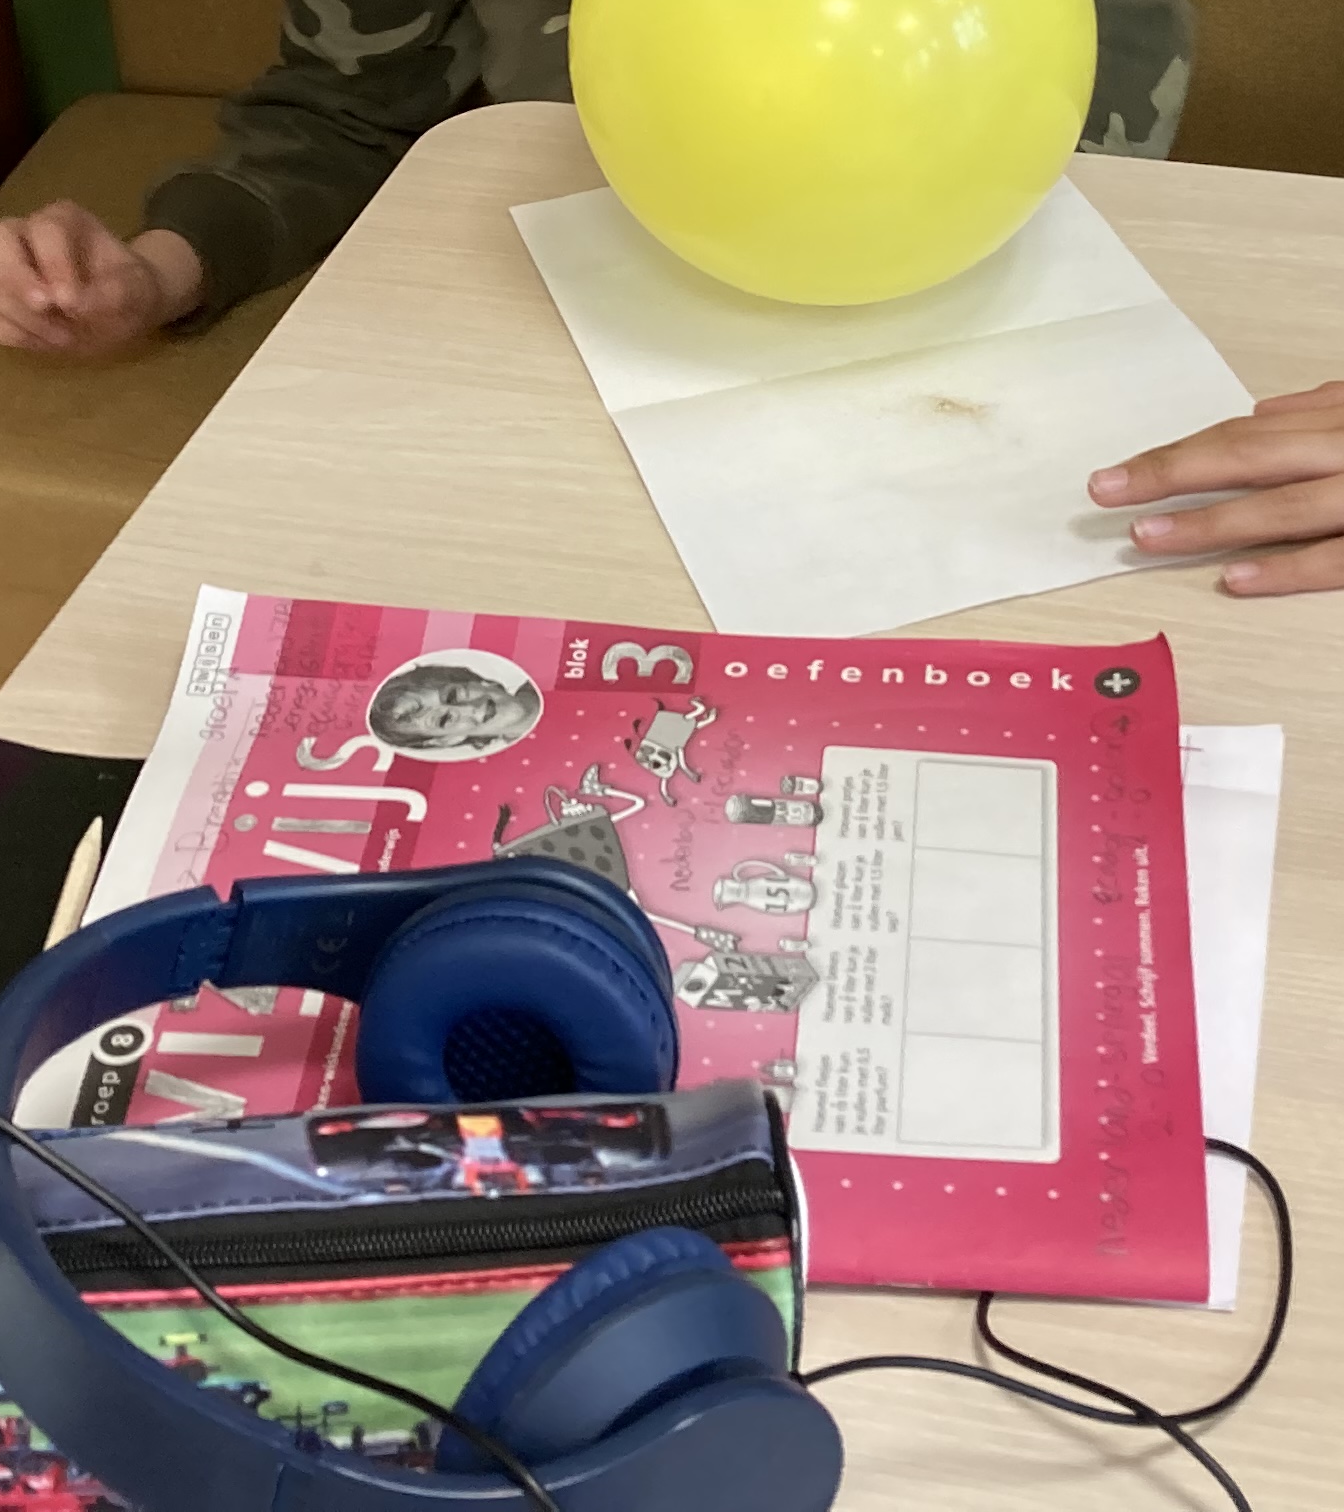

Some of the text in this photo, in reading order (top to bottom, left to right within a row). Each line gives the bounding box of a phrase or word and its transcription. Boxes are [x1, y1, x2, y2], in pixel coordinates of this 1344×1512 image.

[189, 613, 229, 695] zwijsen
[563, 635, 695, 687] blok 3
[723, 656, 1074, 695] oefenboek
[111, 1032, 135, 1050] 8
